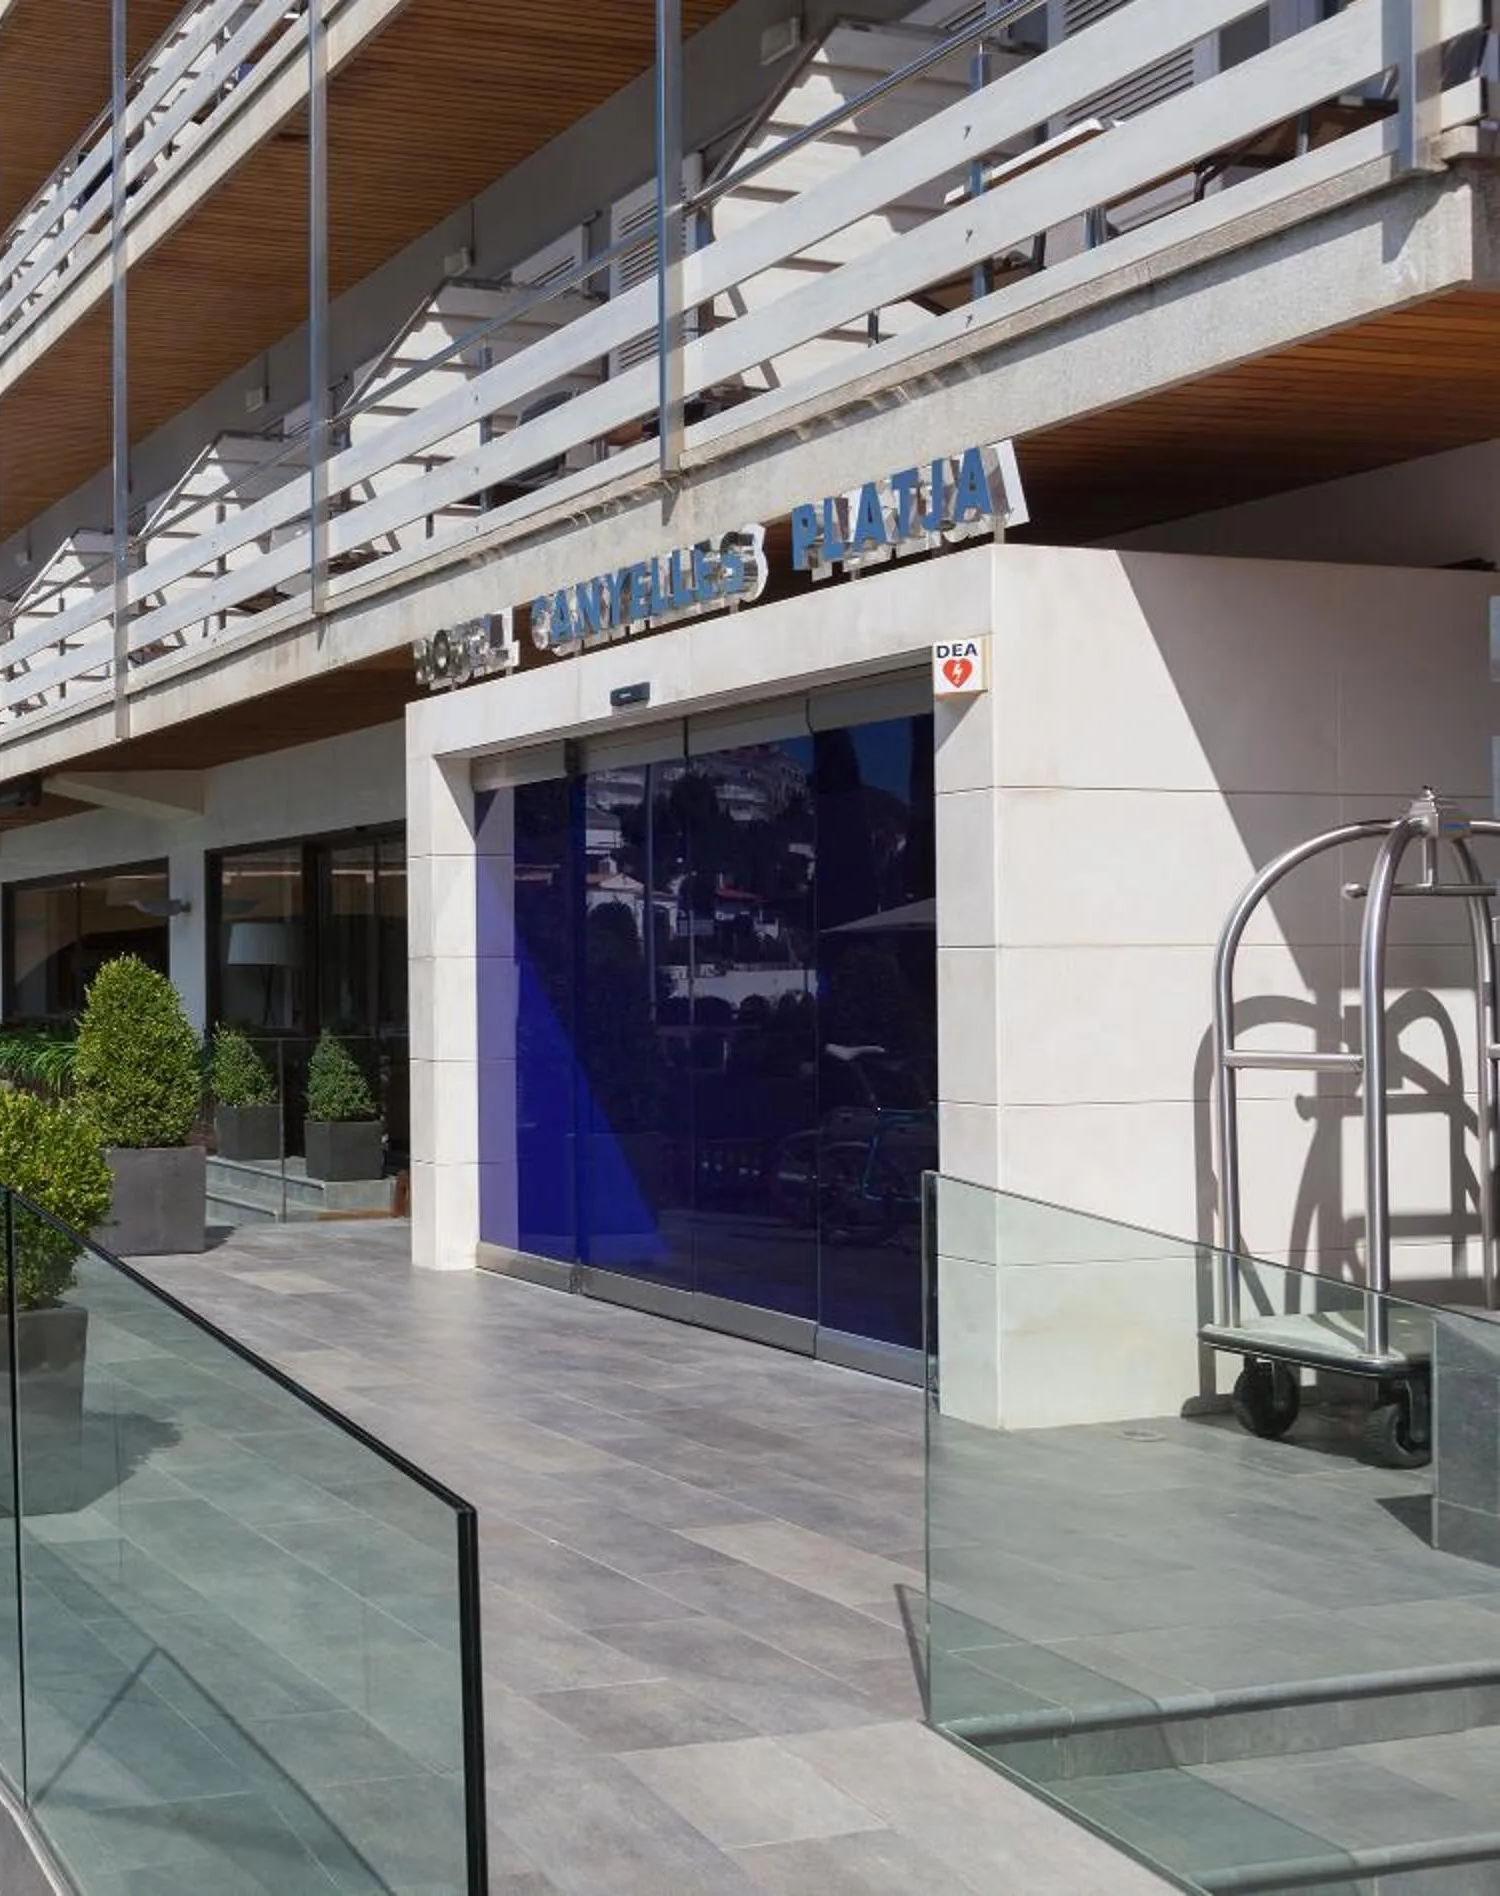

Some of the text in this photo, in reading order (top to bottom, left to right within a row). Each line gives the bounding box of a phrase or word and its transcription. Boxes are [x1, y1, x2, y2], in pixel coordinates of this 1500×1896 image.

[531, 525, 768, 656] CANYELLES
[791, 441, 1026, 578] PLATJA
[936, 643, 978, 659] DEA
